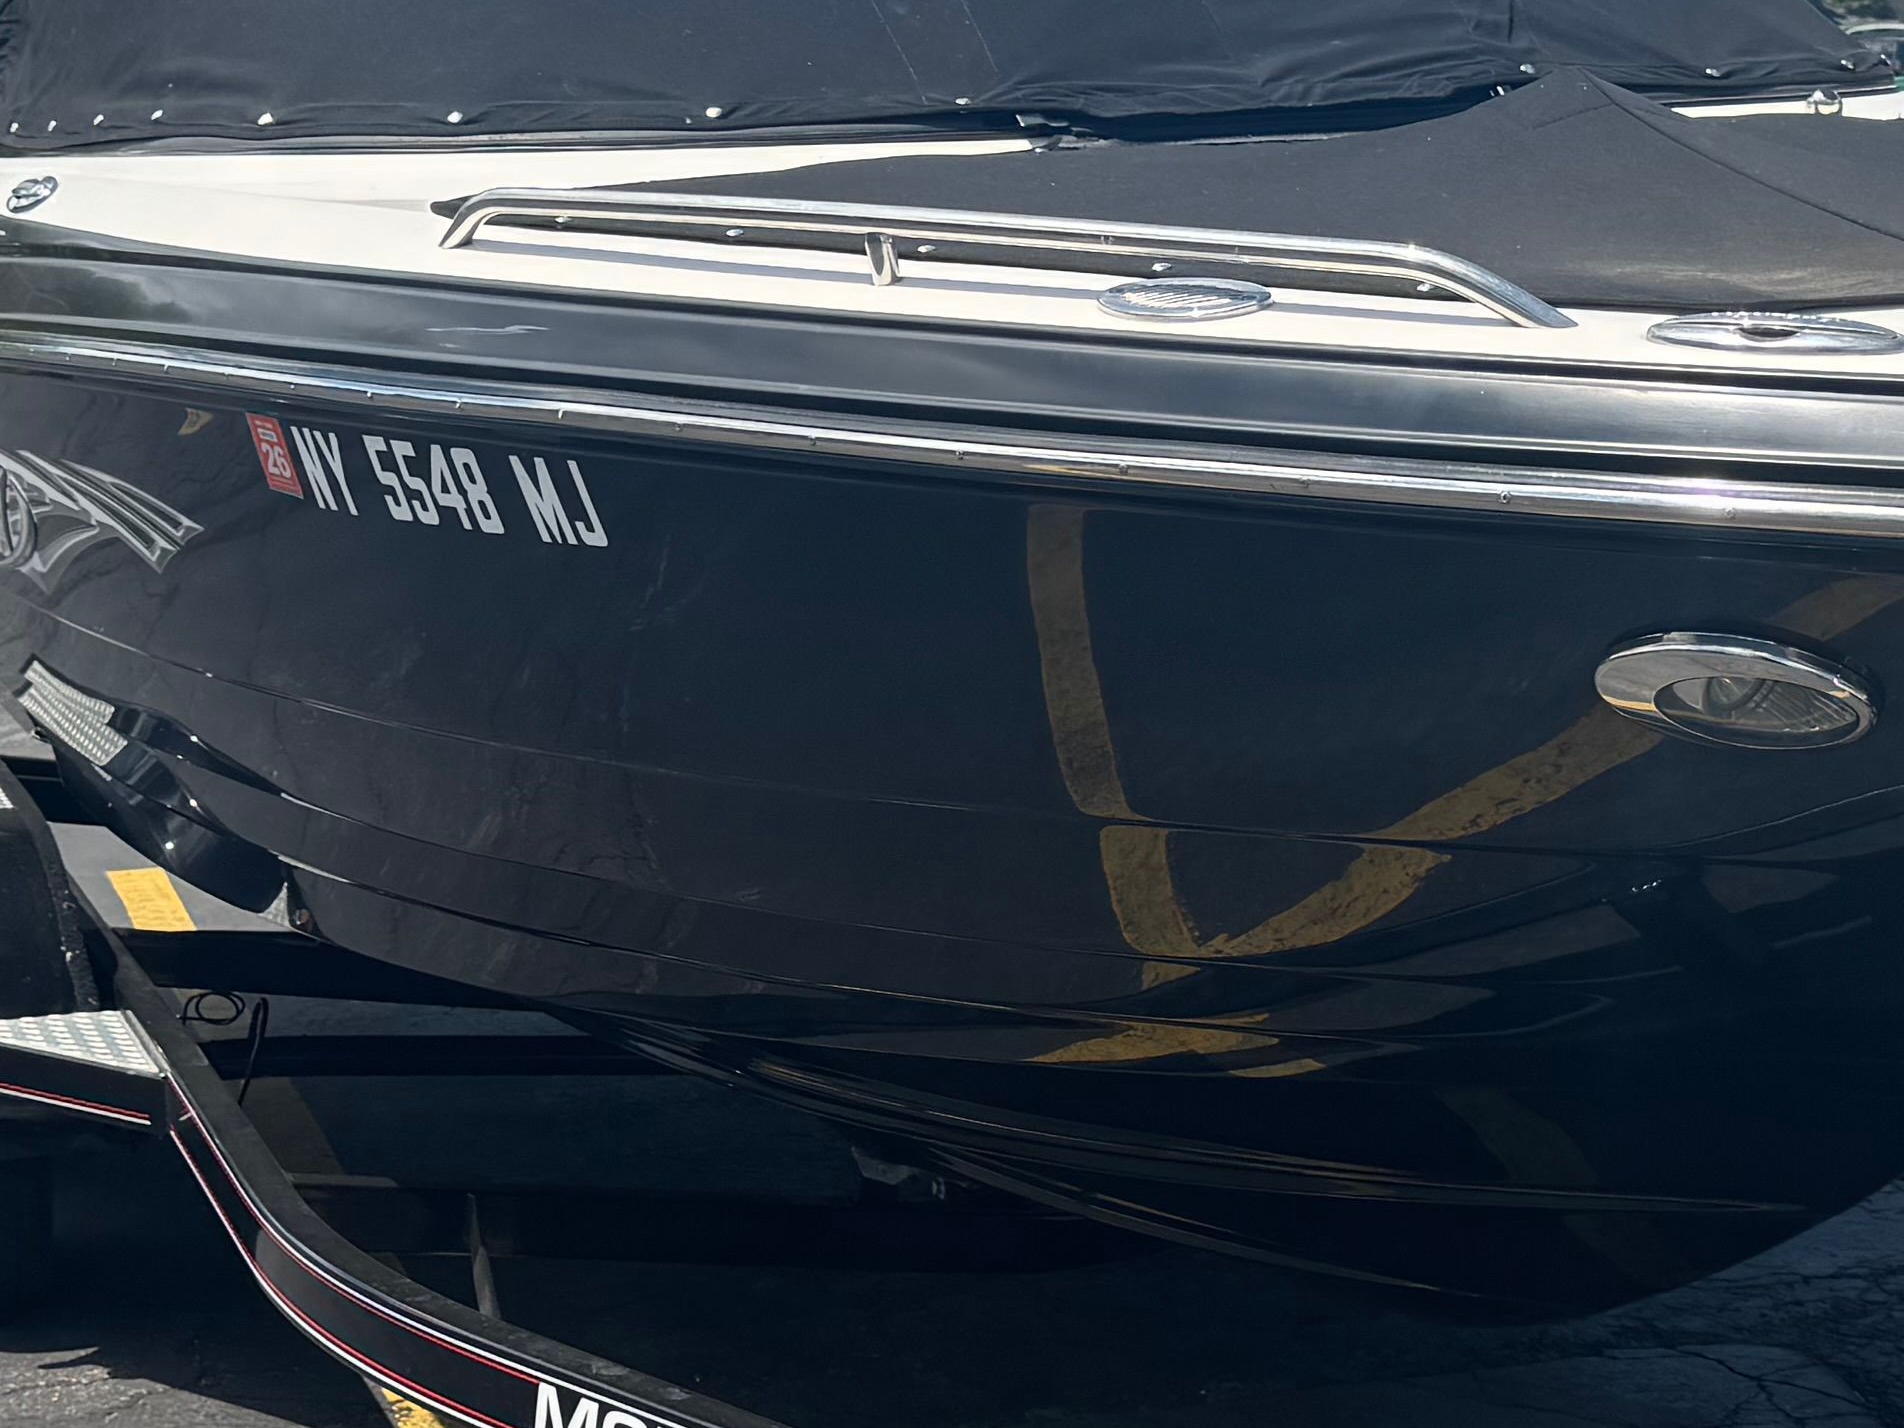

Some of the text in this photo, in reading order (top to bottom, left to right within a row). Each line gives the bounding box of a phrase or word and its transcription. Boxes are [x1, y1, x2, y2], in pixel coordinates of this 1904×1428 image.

[260, 441, 292, 479] 26
[290, 425, 609, 548] NY 5548 MJ
